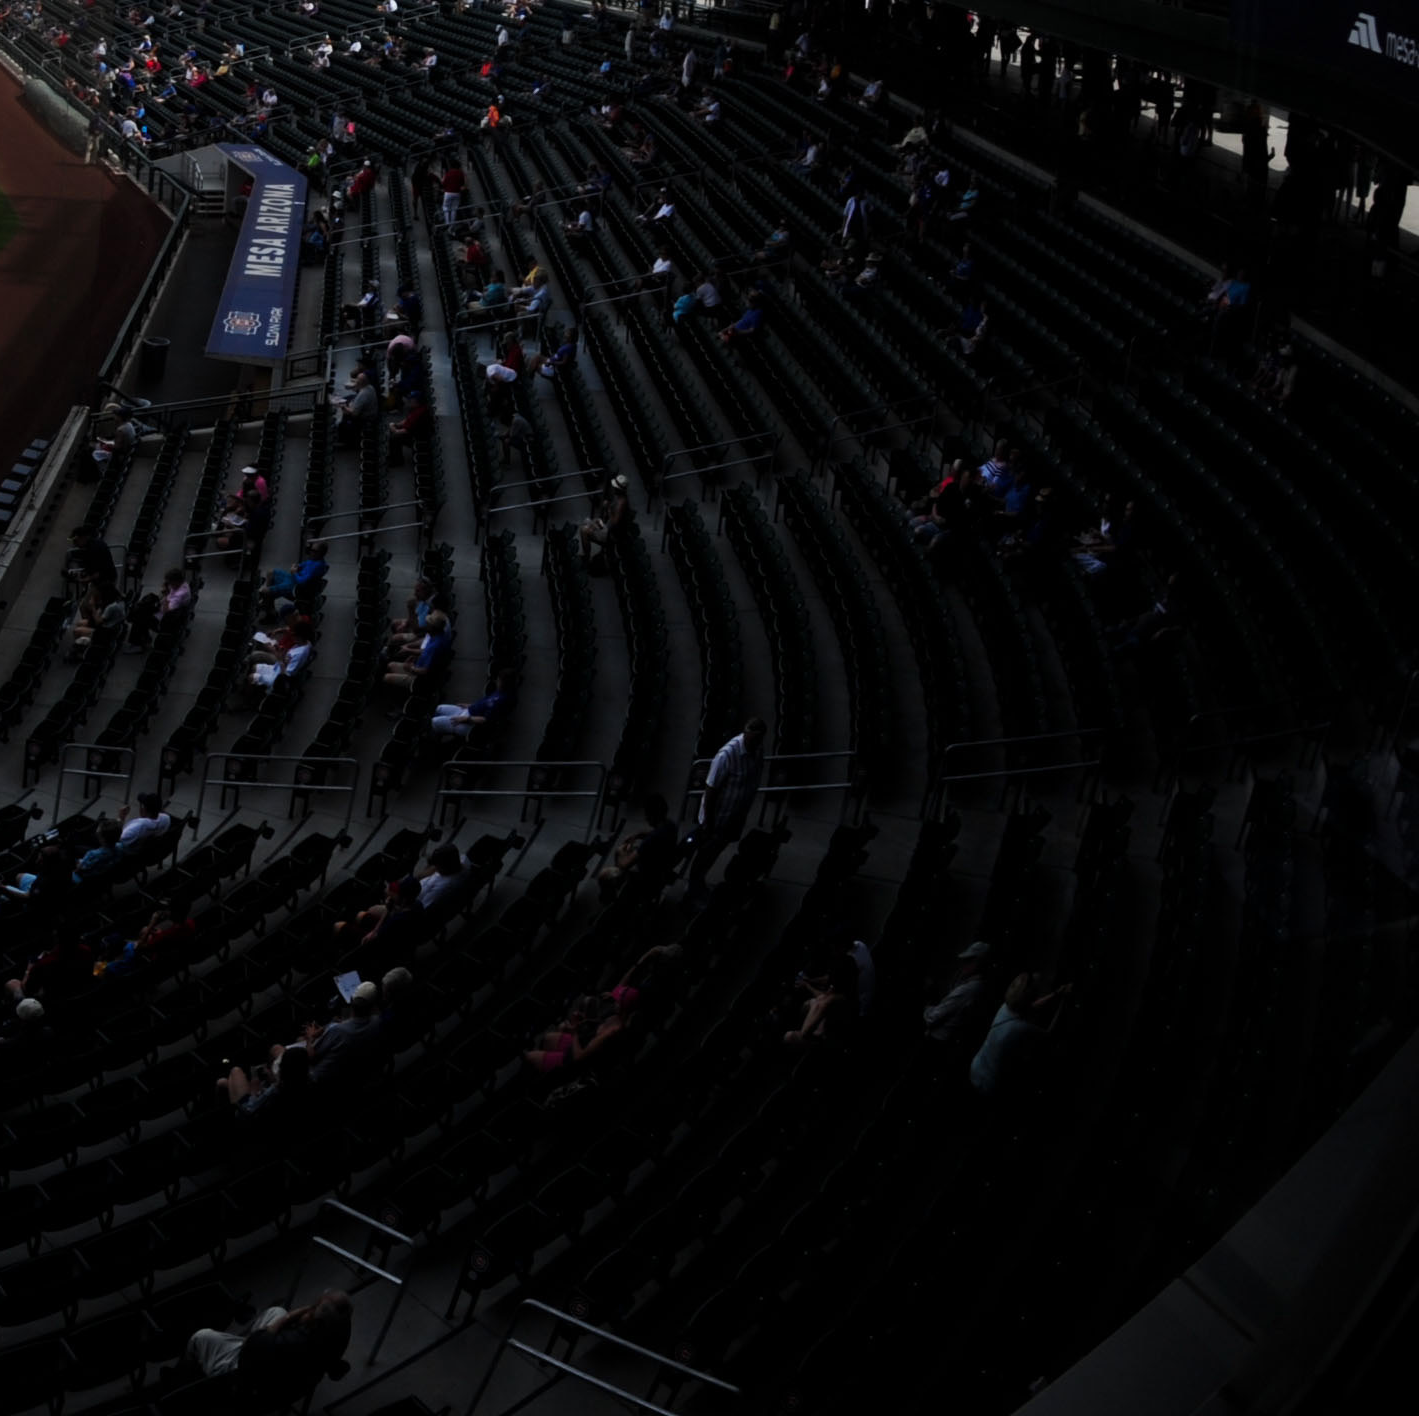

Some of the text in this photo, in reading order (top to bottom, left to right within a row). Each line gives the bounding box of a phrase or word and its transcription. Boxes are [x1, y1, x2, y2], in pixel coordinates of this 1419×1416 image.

[1385, 31, 1419, 71] mesa
[255, 184, 295, 234] ARIZONA
[244, 238, 287, 277] MESA
